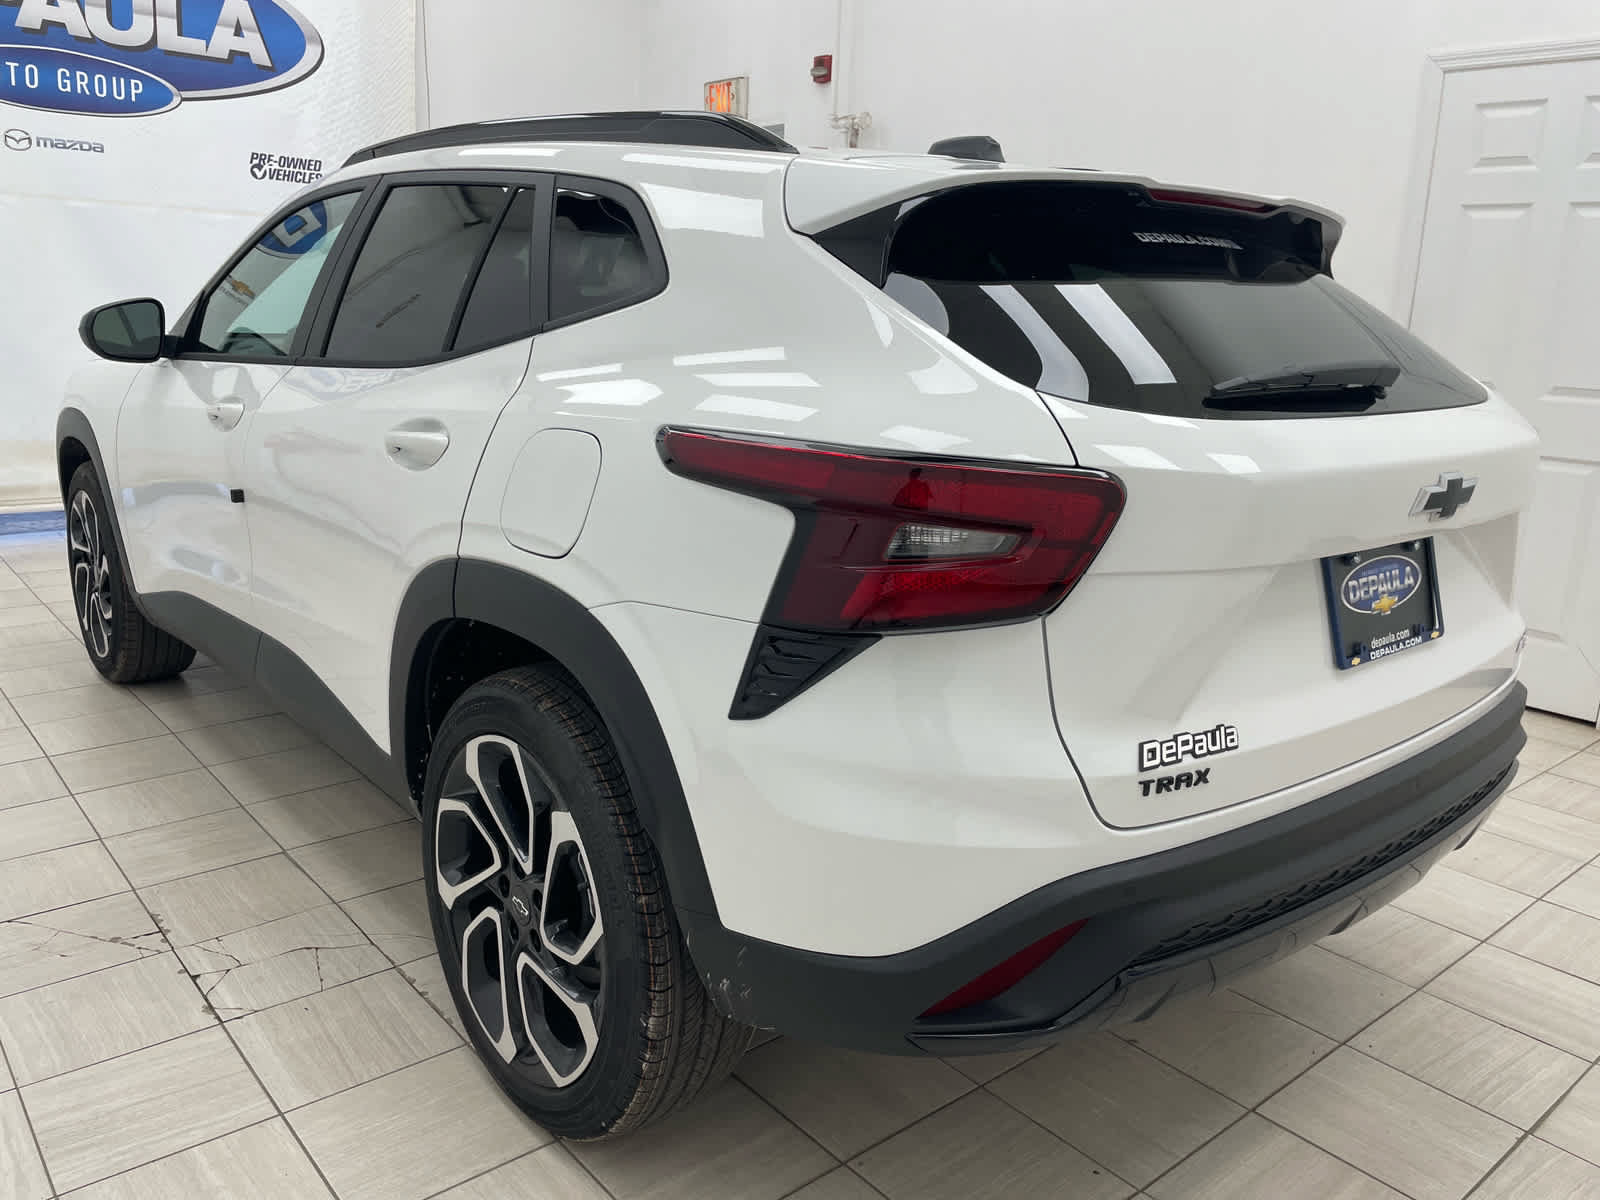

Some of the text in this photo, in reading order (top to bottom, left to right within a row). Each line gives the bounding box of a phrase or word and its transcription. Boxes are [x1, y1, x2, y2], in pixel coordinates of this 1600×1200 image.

[57, 68, 144, 102] GROUP
[708, 81, 732, 113] EXIT
[36, 136, 105, 153] mazda
[249, 152, 322, 172] PRE-OWNED
[1347, 565, 1415, 604] DEPAULA
[1370, 636, 1422, 660] DEPAULA.COM
[1371, 628, 1410, 649] depaula.com
[1139, 724, 1239, 771] DePaula
[1138, 768, 1210, 797] TRAX
